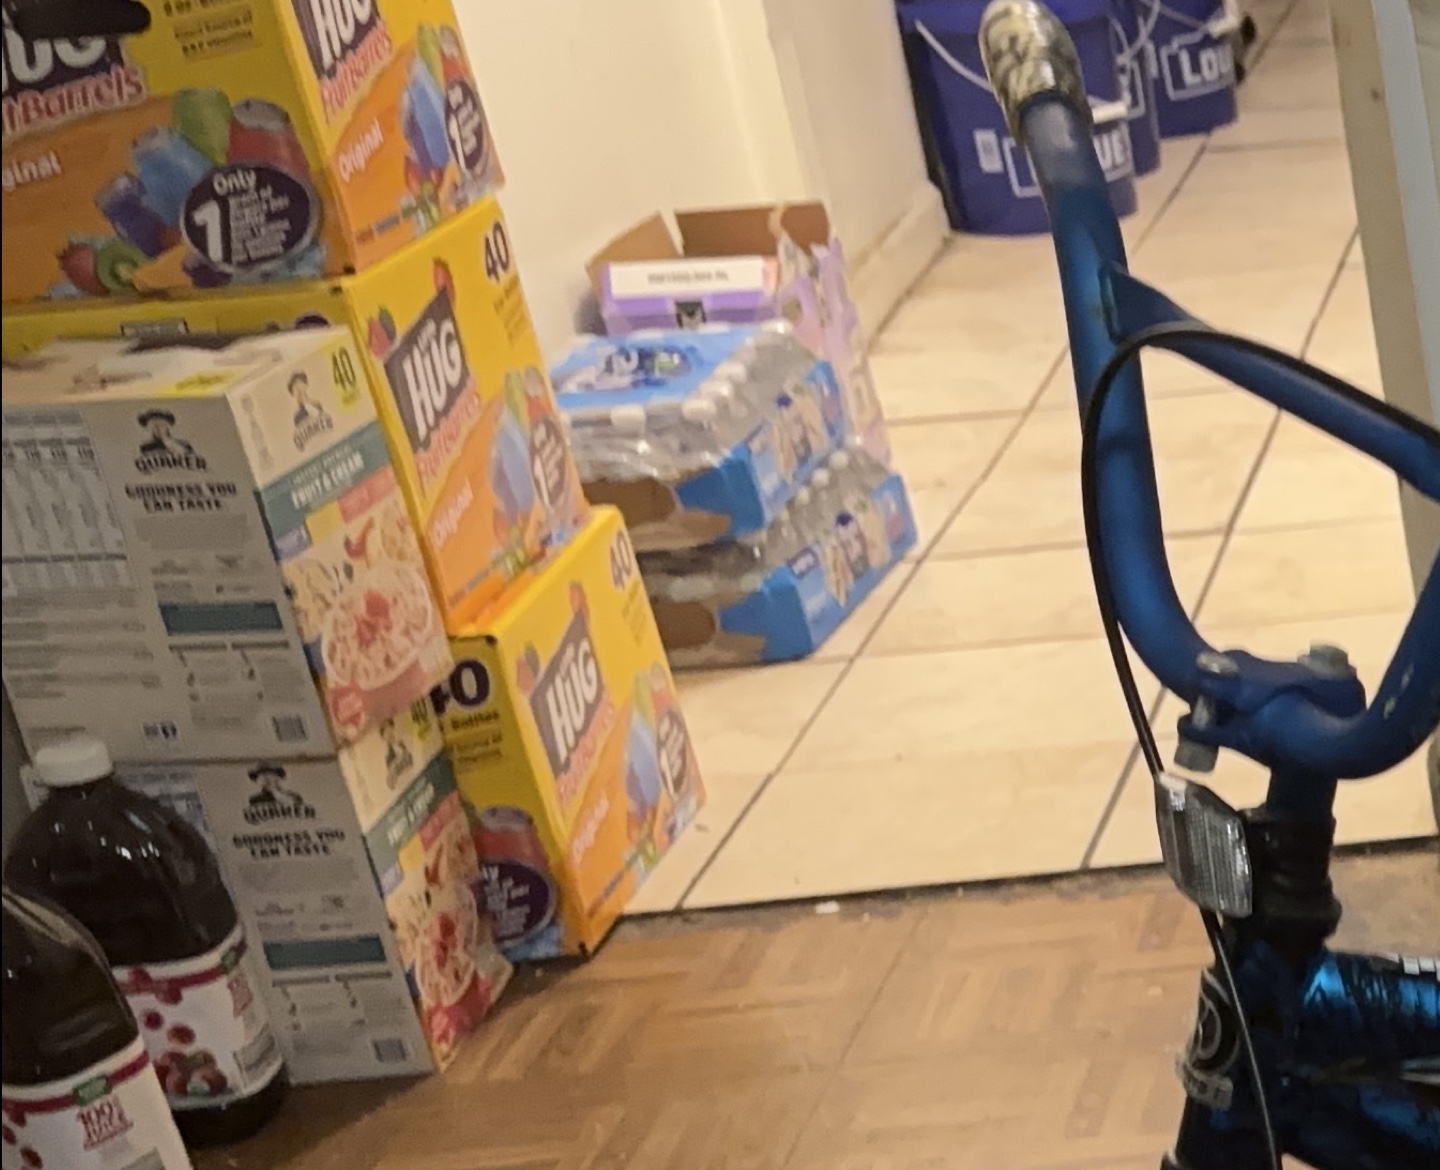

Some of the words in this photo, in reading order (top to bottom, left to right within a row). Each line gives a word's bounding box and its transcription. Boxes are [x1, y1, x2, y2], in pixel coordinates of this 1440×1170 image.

[2, 150, 62, 193] ginal
[212, 167, 258, 196] Only
[192, 199, 224, 265] 1
[484, 220, 510, 281] 40
[332, 345, 356, 392] 40
[402, 318, 462, 442] HUG
[609, 529, 632, 591] 40
[547, 636, 599, 766] HUG
